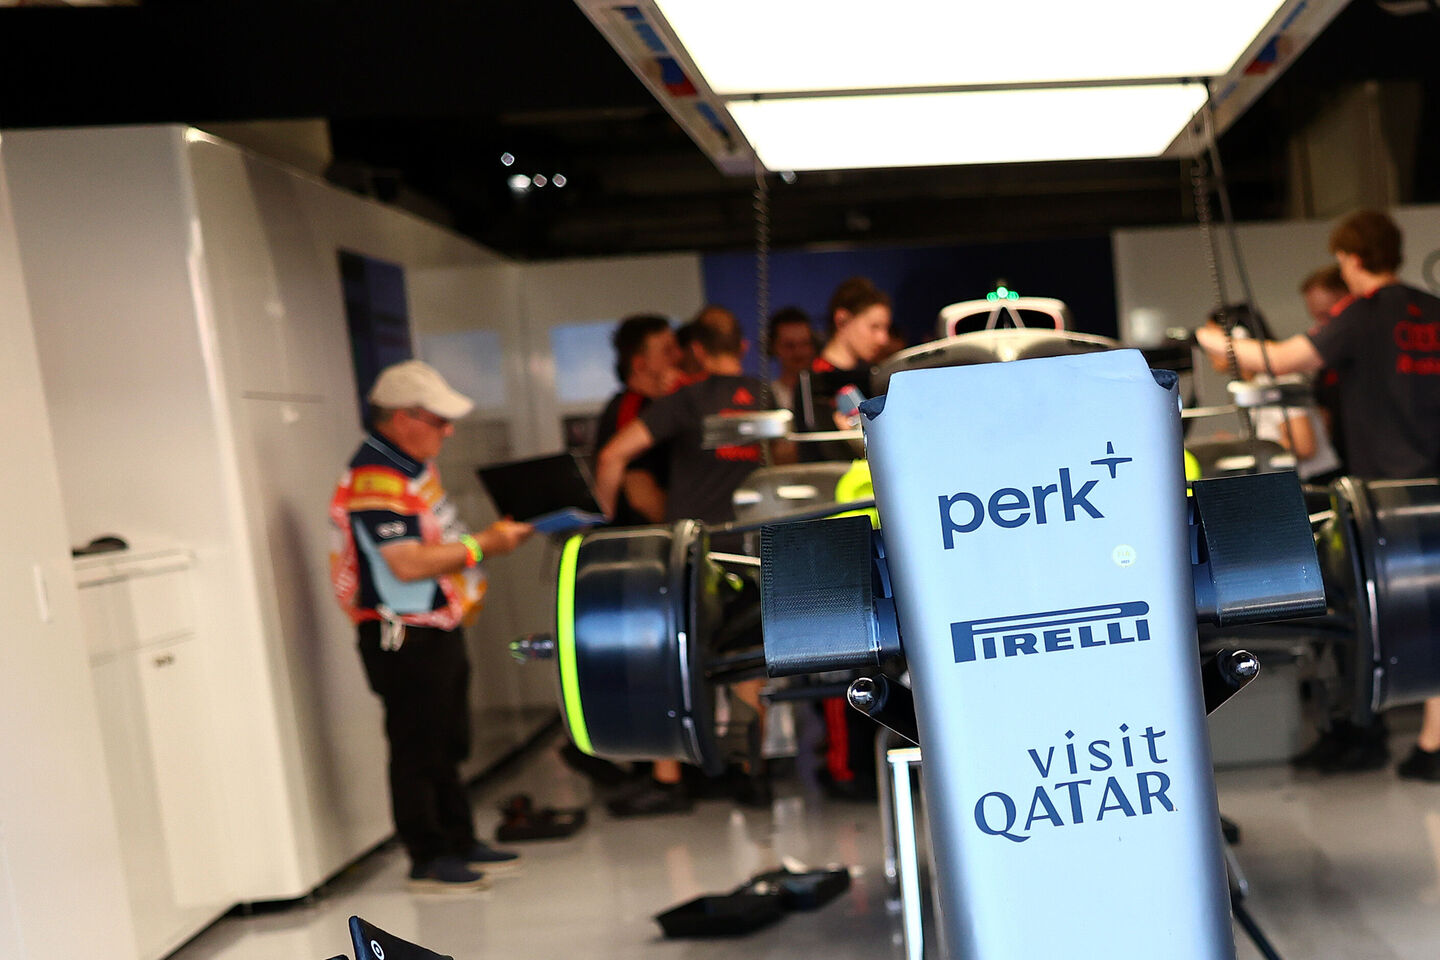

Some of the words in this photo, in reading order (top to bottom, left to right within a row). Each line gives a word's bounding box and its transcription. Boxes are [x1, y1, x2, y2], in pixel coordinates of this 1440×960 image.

[950, 601, 1150, 663] PIRELLI
[1027, 723, 1168, 778] visit
[974, 771, 1178, 843] QATAR
